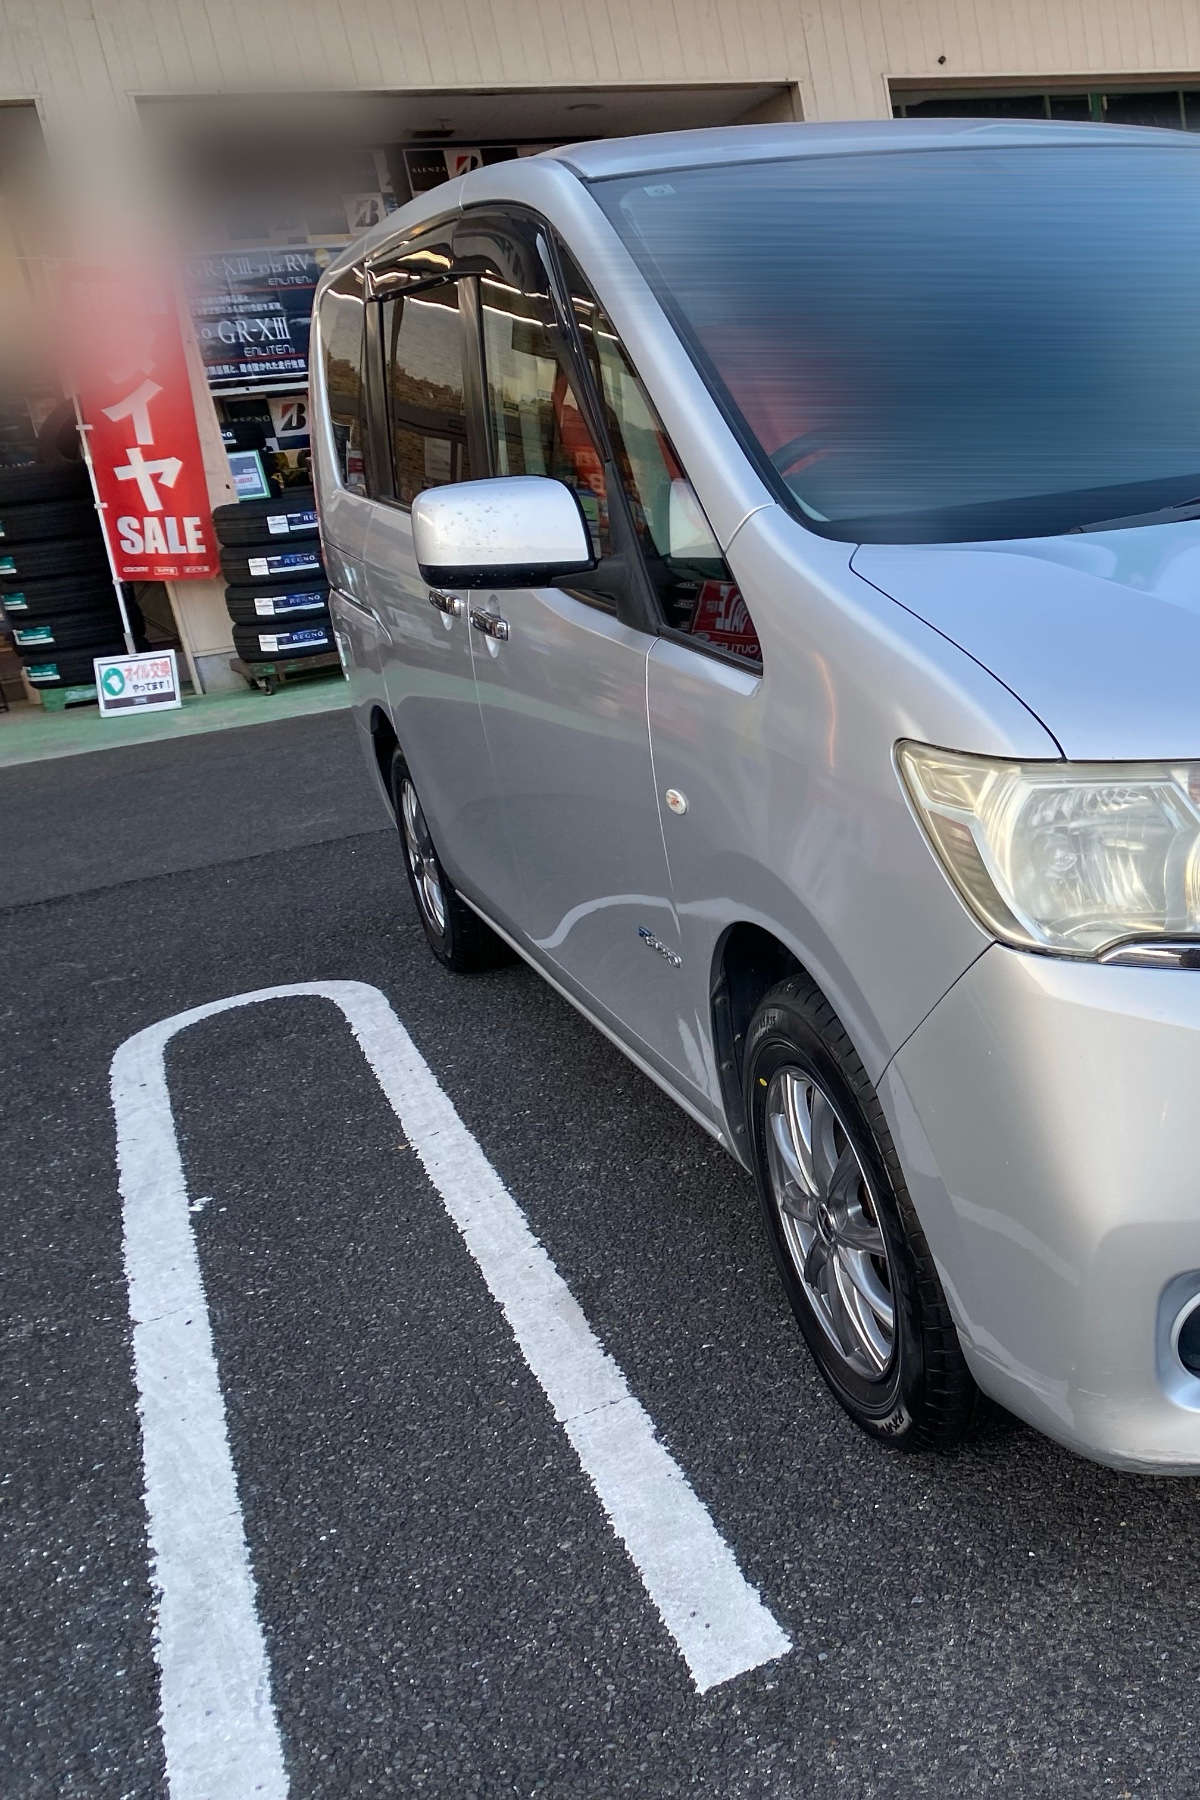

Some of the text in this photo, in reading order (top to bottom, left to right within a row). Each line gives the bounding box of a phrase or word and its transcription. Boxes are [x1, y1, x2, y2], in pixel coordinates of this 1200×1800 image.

[116, 515, 206, 554] SALE
[284, 554, 316, 564] REGNO
[289, 594, 321, 604] REGNO
[292, 630, 324, 641] REGNO
